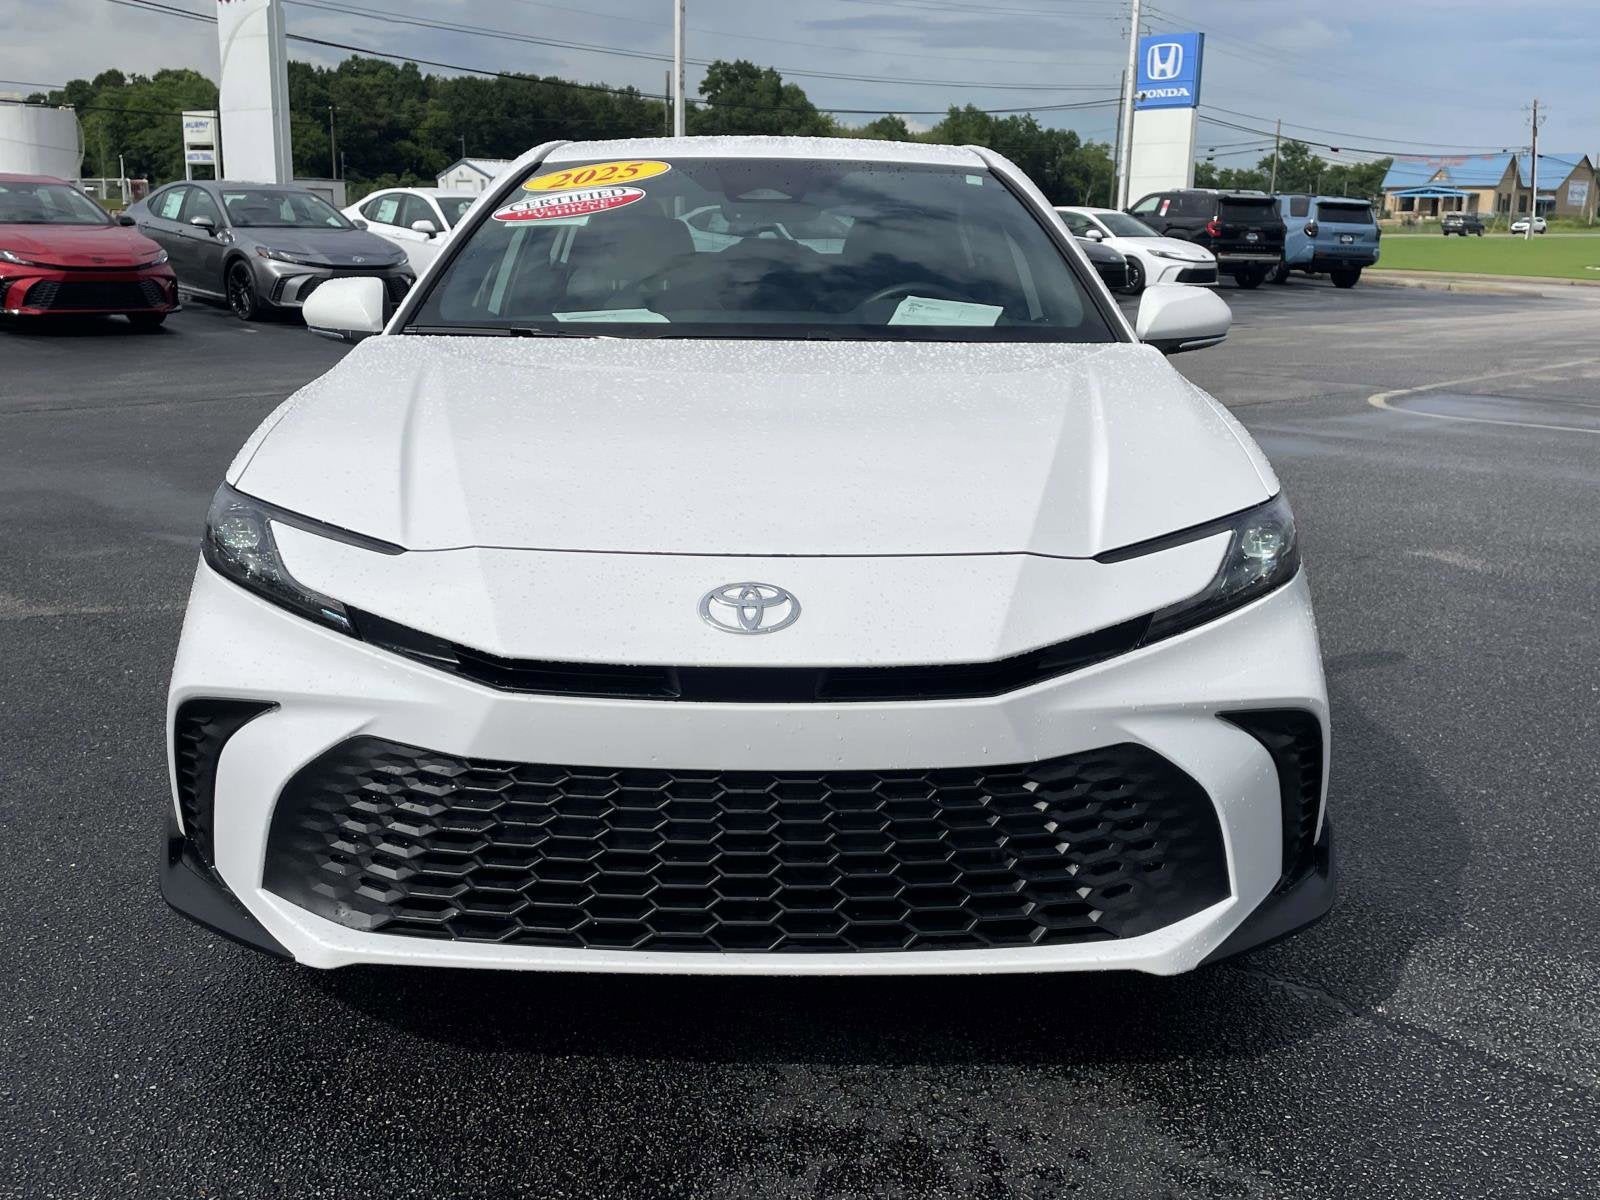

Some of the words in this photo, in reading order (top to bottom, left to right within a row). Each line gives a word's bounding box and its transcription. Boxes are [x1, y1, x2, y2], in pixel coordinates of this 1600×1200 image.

[547, 163, 643, 189] 2025
[509, 188, 626, 211] CERTIFIED
[534, 203, 610, 218] VEHICLE
